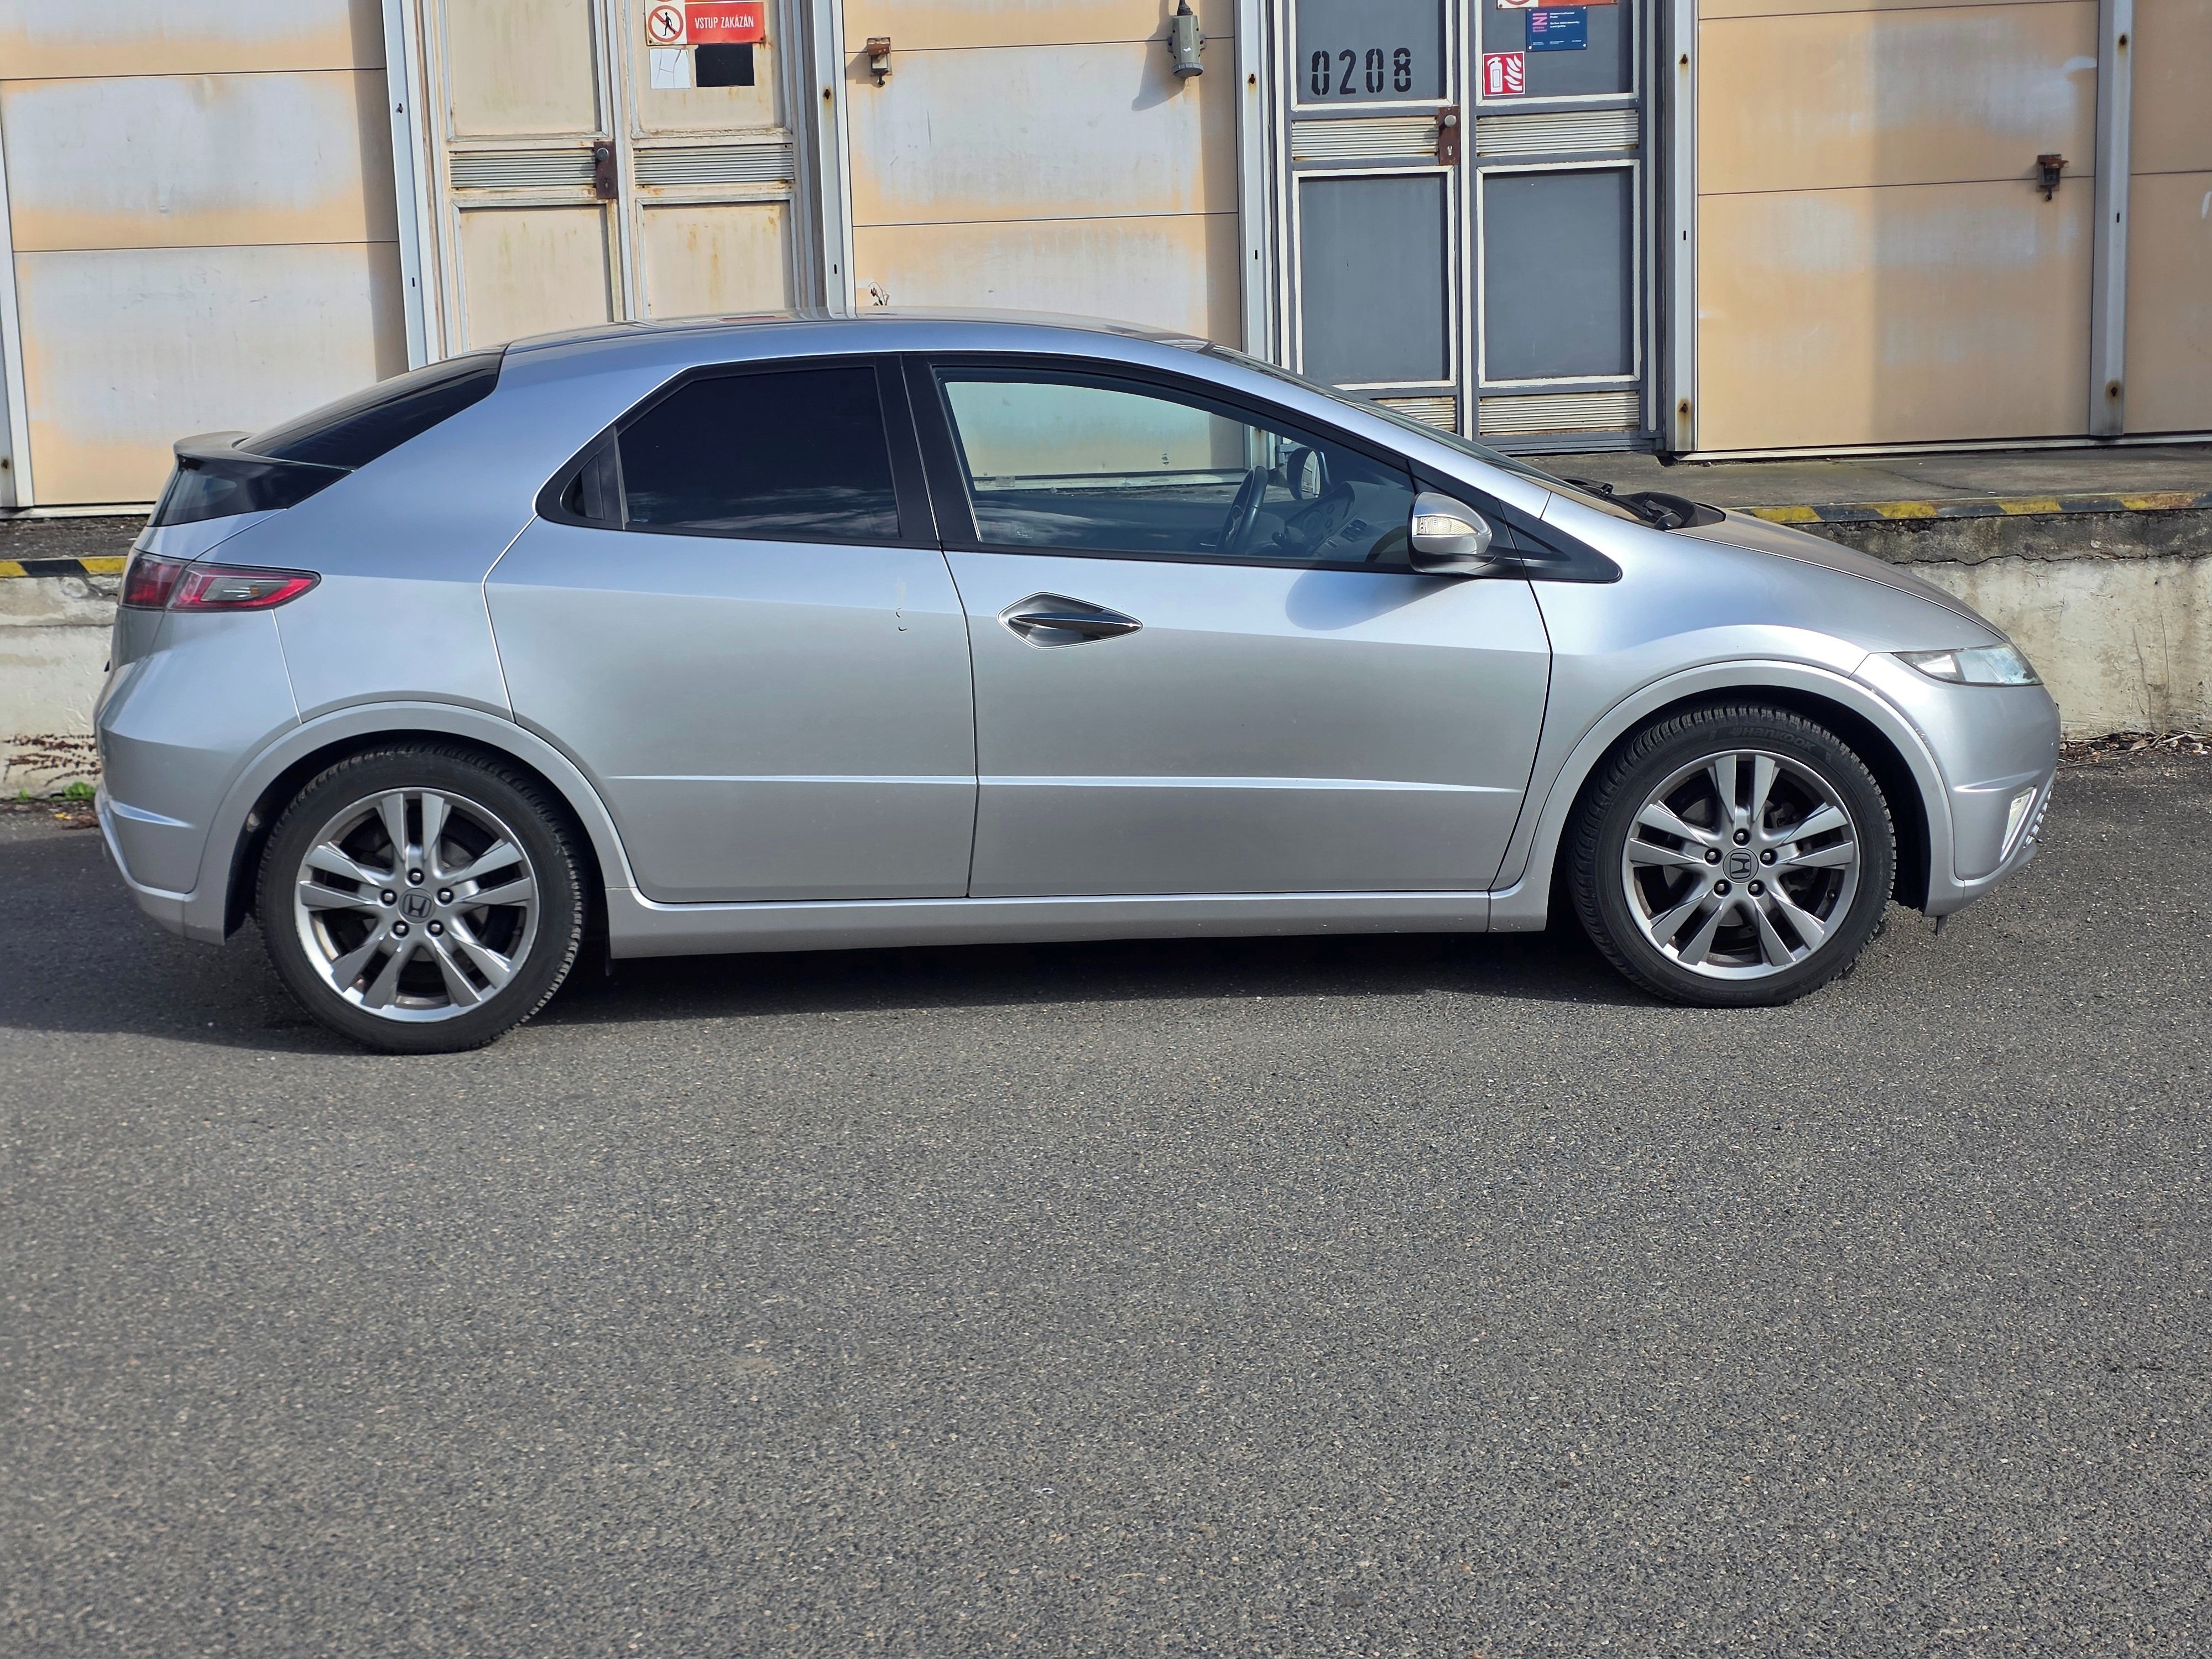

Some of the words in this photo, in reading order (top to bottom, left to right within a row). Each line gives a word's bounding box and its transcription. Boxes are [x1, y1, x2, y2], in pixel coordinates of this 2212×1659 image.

[694, 17, 718, 29] VSTUP
[721, 13, 754, 28] ZAKÁZÁN
[1311, 47, 1411, 96] 0208
